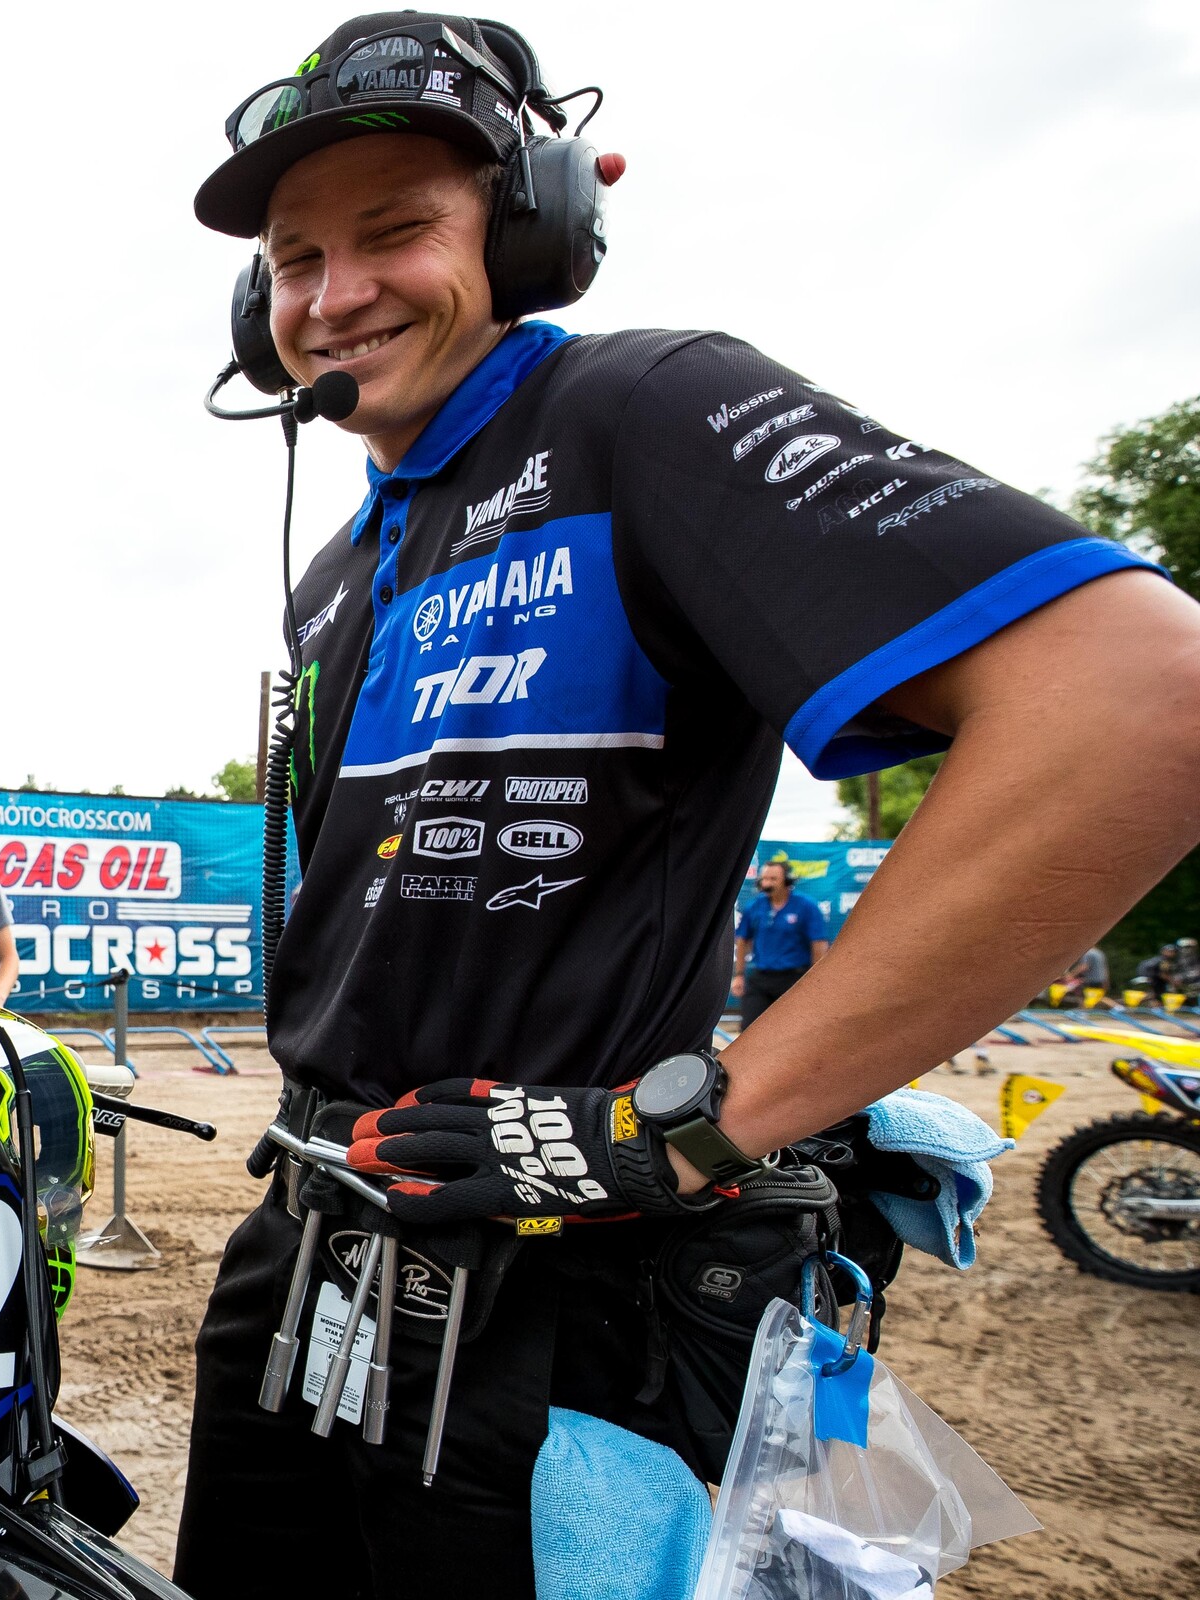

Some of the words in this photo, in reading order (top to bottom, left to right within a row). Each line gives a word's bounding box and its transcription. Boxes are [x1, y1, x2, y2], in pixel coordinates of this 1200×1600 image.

[707, 386, 784, 434] Wössner
[847, 478, 908, 519] EXCEL
[448, 546, 574, 629] YAMAHA
[419, 604, 557, 654] RAING
[507, 778, 585, 801] PROTAPER
[423, 827, 478, 849] 100%
[510, 830, 570, 849] BELL
[100, 844, 170, 891] OIL
